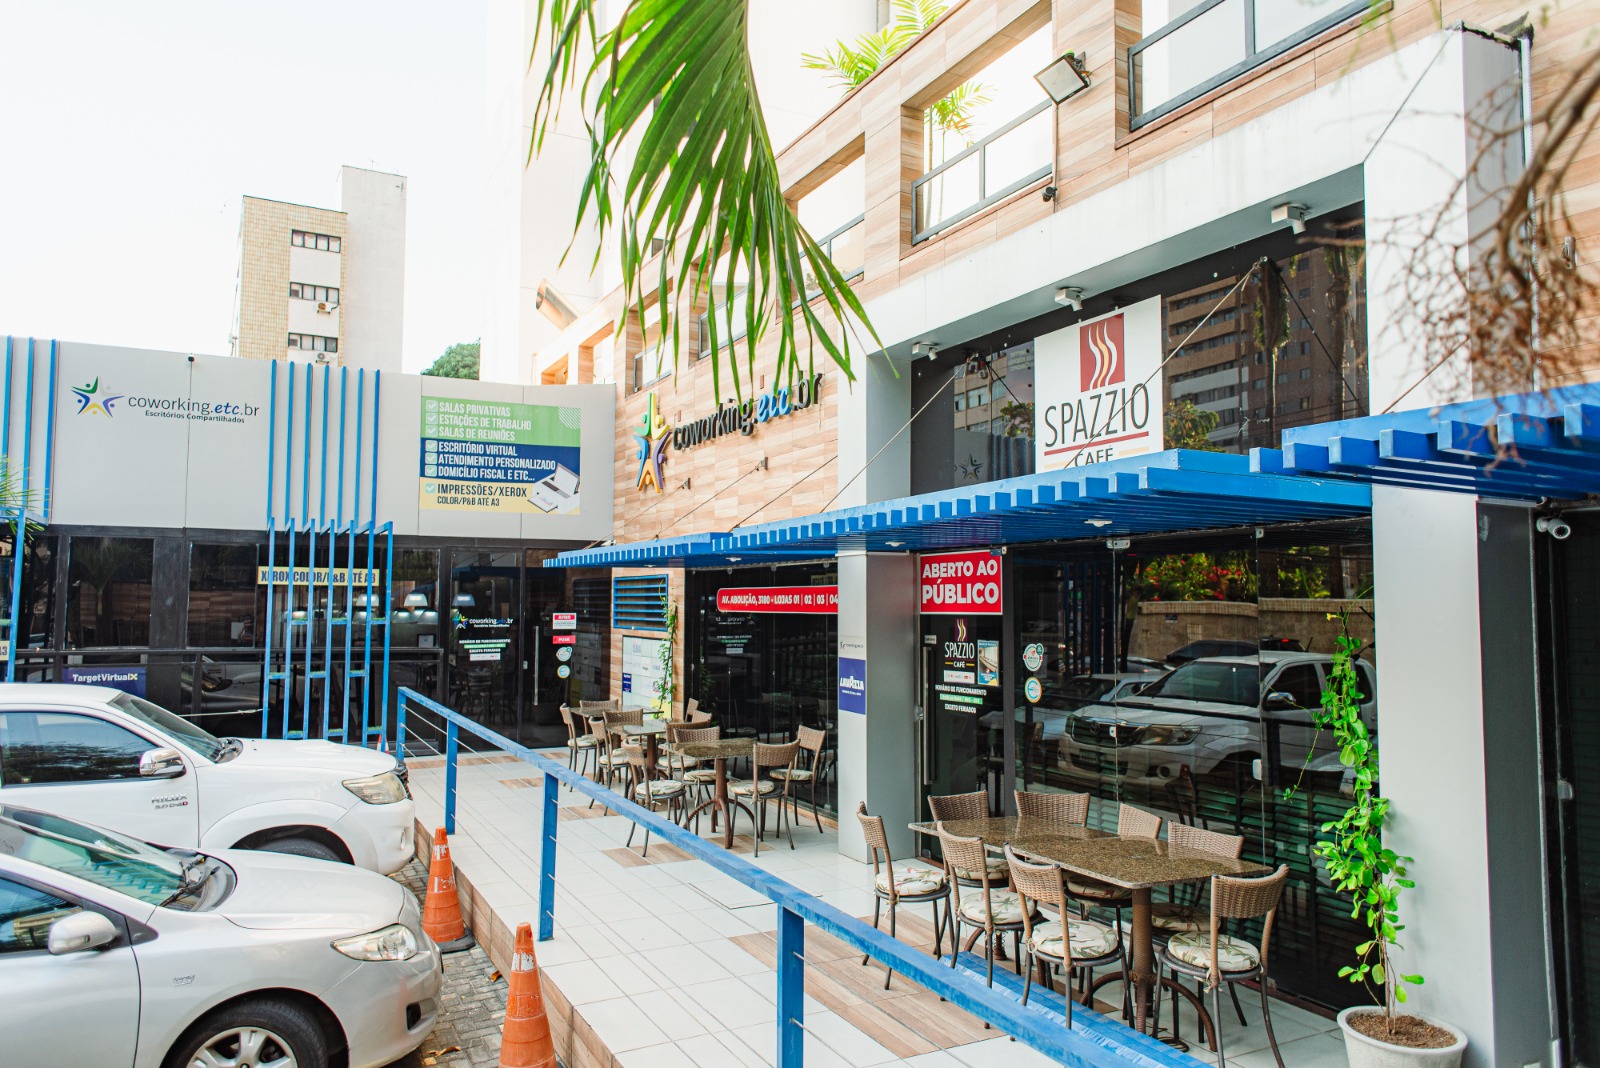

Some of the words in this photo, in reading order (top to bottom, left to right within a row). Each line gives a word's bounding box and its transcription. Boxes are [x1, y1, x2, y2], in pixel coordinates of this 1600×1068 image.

[128, 396, 260, 416] coworking.etc.br
[439, 402, 464, 414] SALAS
[466, 403, 511, 417] PRIVATIVAS
[145, 410, 185, 419] Escritórios
[186, 414, 245, 423] Compartilhados
[439, 413, 479, 427] ESTAÇÕES
[480, 416, 490, 428] DE
[492, 418, 532, 431] TRABALHO
[1044, 382, 1150, 448] SPAZZIO
[439, 427, 464, 438] SALAS
[466, 428, 476, 439] DE
[478, 427, 516, 441] REUNIÕES
[438, 441, 485, 454] ESCRITÓRIO
[485, 445, 518, 457] VIRTUAL
[438, 454, 494, 468] ATENDIMENTO
[495, 458, 556, 471] PERSONALIZADO
[438, 465, 479, 478] DOMICÍLIO
[480, 468, 507, 480] FISCAL
[507, 470, 513, 480] E
[514, 470, 535, 482] ETC...
[437, 483, 527, 498] IMPRESSÕES/XEROX
[437, 496, 476, 506] COLOR/P&B
[477, 495, 490, 506] ATÉ
[491, 498, 500, 507] A3
[347, 571, 363, 583] TÉ
[922, 560, 974, 579] ABERTO
[976, 559, 998, 576] AO
[774, 595, 792, 605] LOJAS
[793, 594, 800, 604] 01
[804, 594, 812, 604] 02
[817, 594, 825, 604] 03
[922, 579, 999, 604] PÚBLICO
[944, 641, 975, 659] SPAZZIO
[953, 660, 966, 668] CAFÉ
